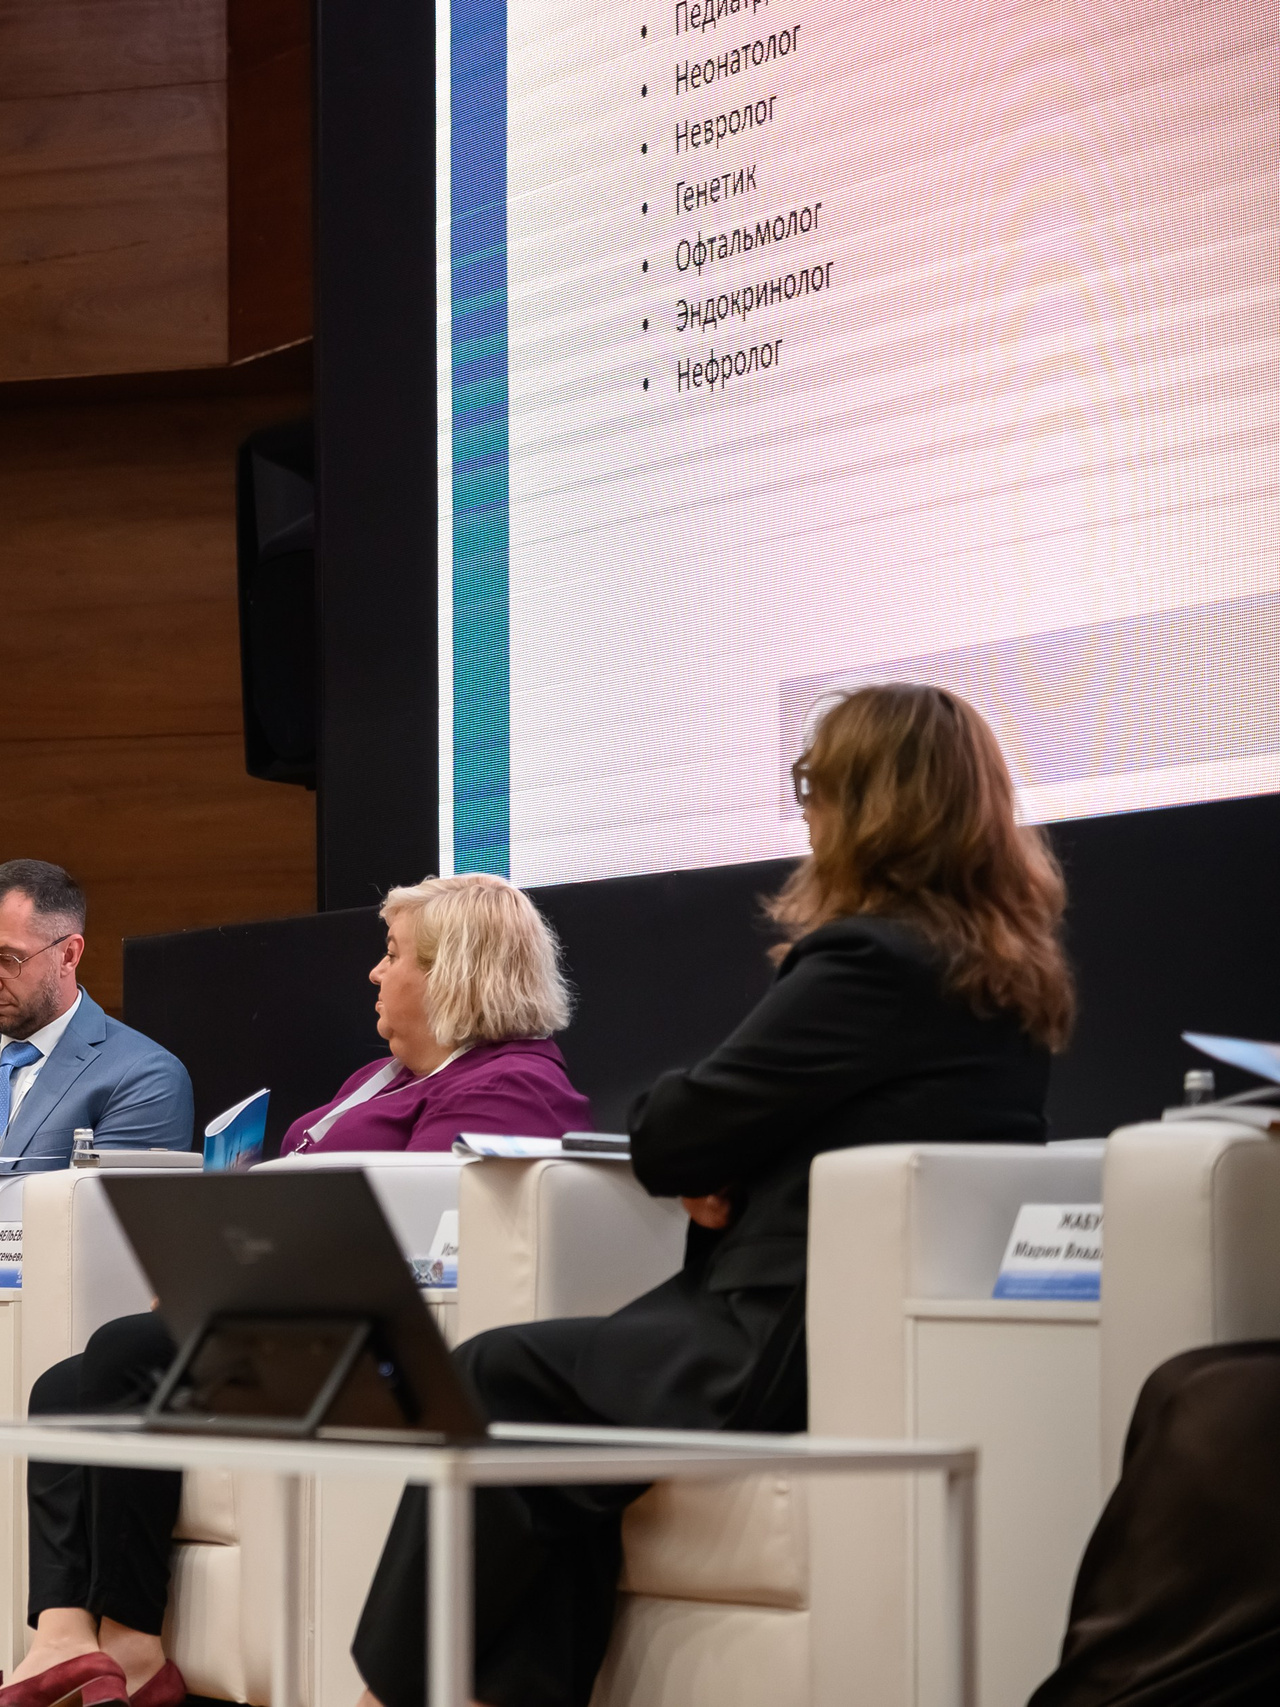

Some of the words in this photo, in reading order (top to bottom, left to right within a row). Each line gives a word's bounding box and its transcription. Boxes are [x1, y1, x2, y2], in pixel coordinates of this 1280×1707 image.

[676, 25, 801, 96] Неонатолог
[676, 96, 777, 155] Невролог
[676, 164, 757, 216] Генетик
[676, 202, 822, 277] Офтальмолог
[676, 261, 834, 333] Эндокринолог
[677, 339, 783, 393] Нефролог
